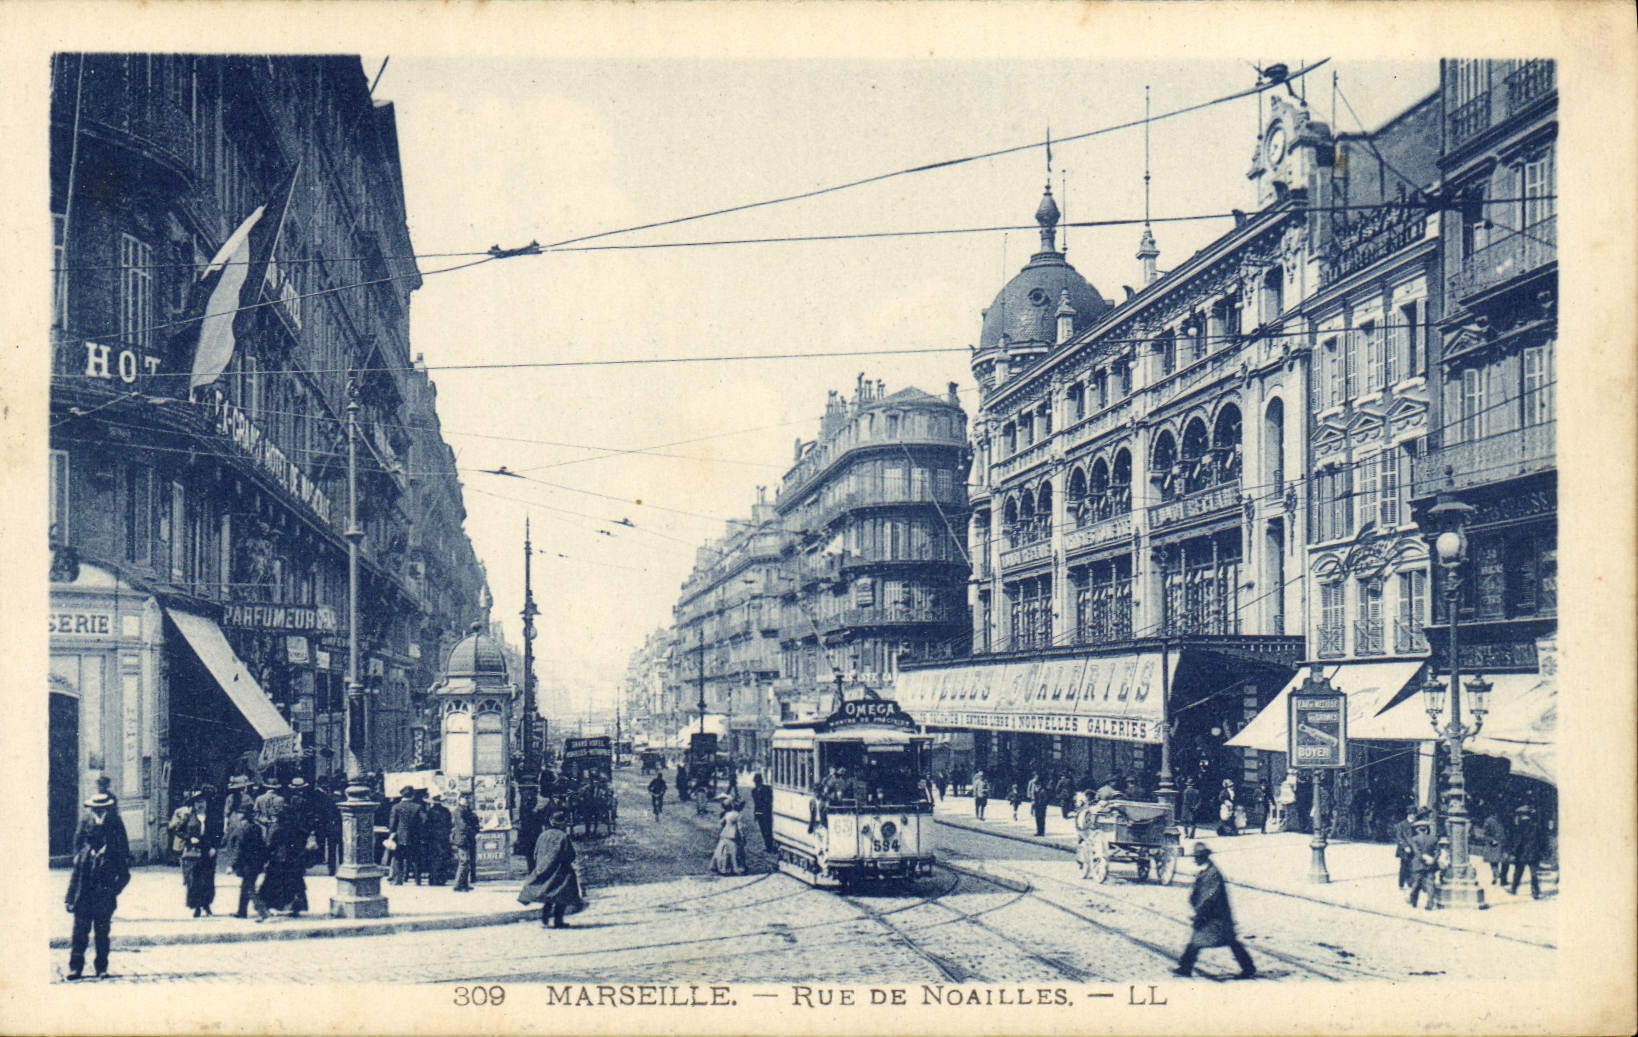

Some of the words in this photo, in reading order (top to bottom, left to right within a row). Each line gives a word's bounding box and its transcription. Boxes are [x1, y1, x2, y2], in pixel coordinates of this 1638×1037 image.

[845, 702, 896, 718] OMEGA
[1018, 714, 1079, 732] NOUVELLES
[1087, 717, 1147, 739] GALERIES
[873, 839, 900, 852] 594
